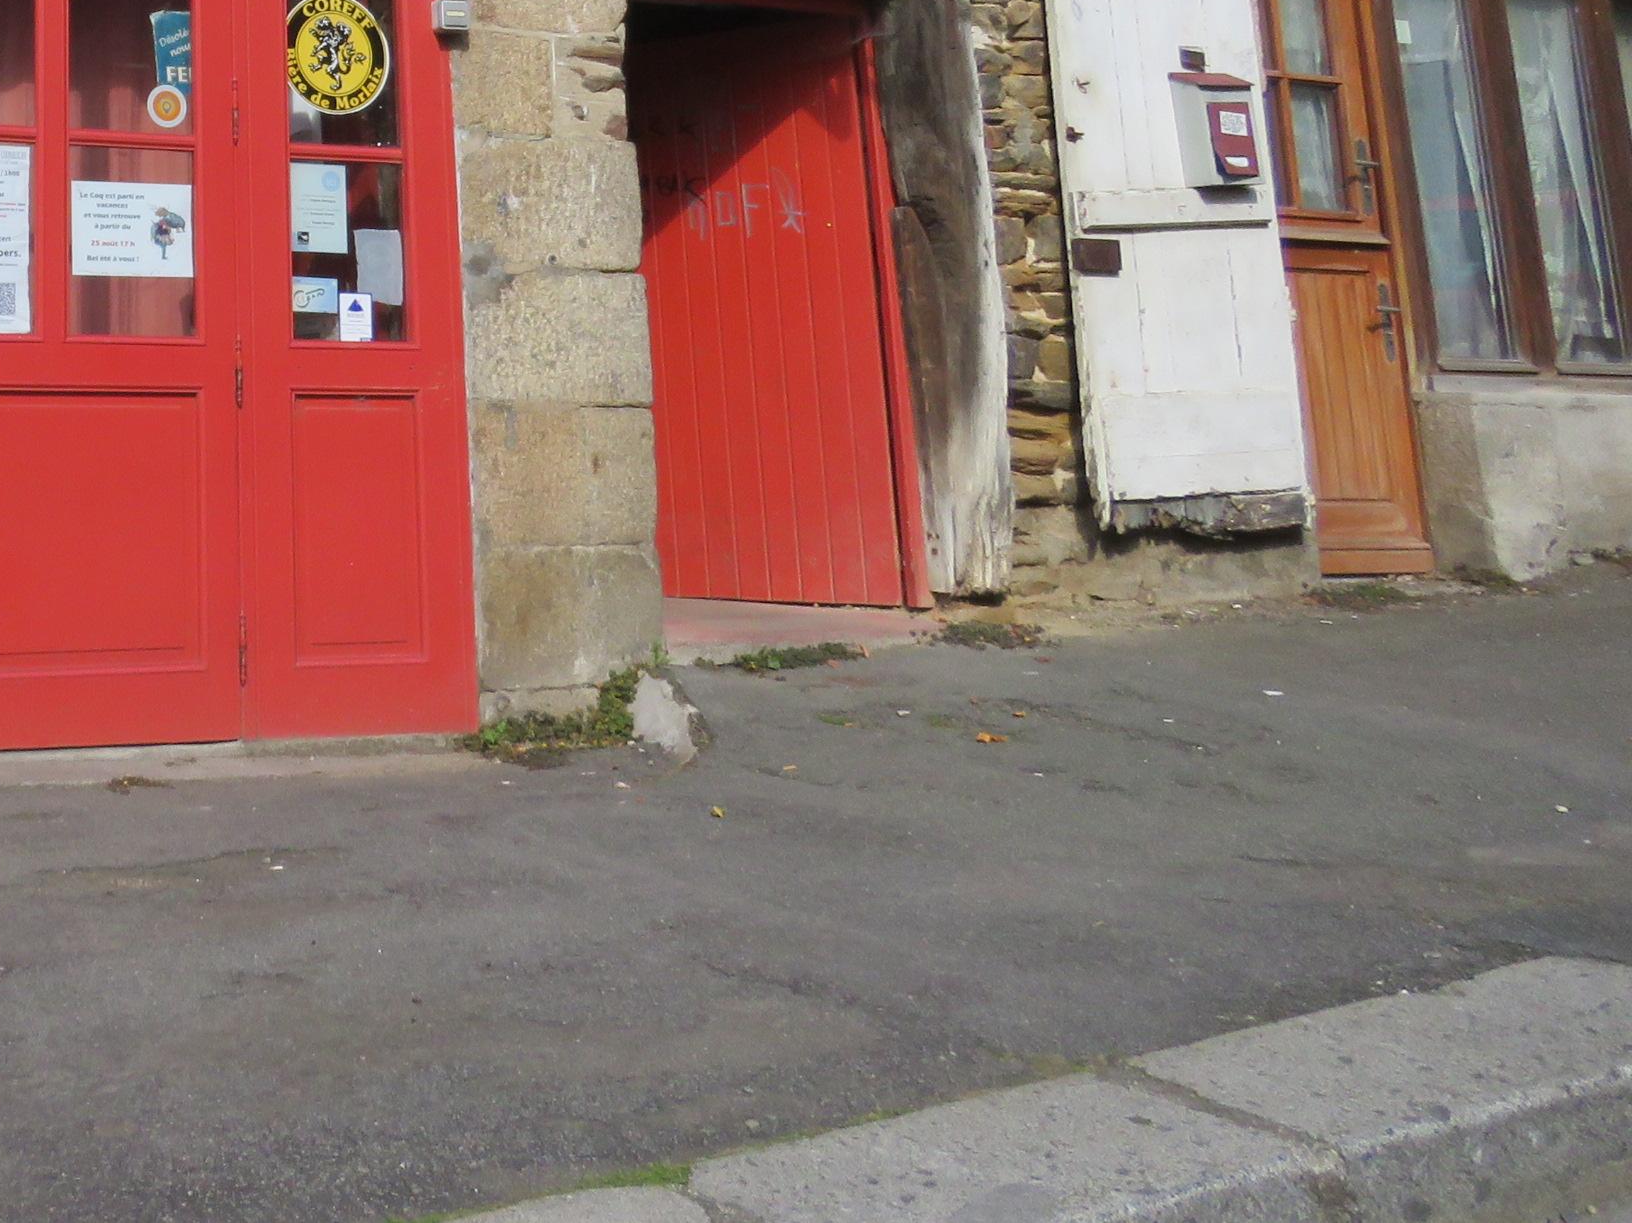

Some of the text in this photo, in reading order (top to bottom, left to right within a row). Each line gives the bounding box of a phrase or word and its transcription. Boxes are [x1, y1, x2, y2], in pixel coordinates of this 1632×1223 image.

[170, 43, 191, 57] nou
[165, 66, 192, 83] FE
[287, 47, 383, 110] Bière de Morlaix
[79, 191, 89, 199] Le
[89, 192, 104, 200] Coq
[117, 193, 134, 201] parti
[91, 239, 100, 247] 25
